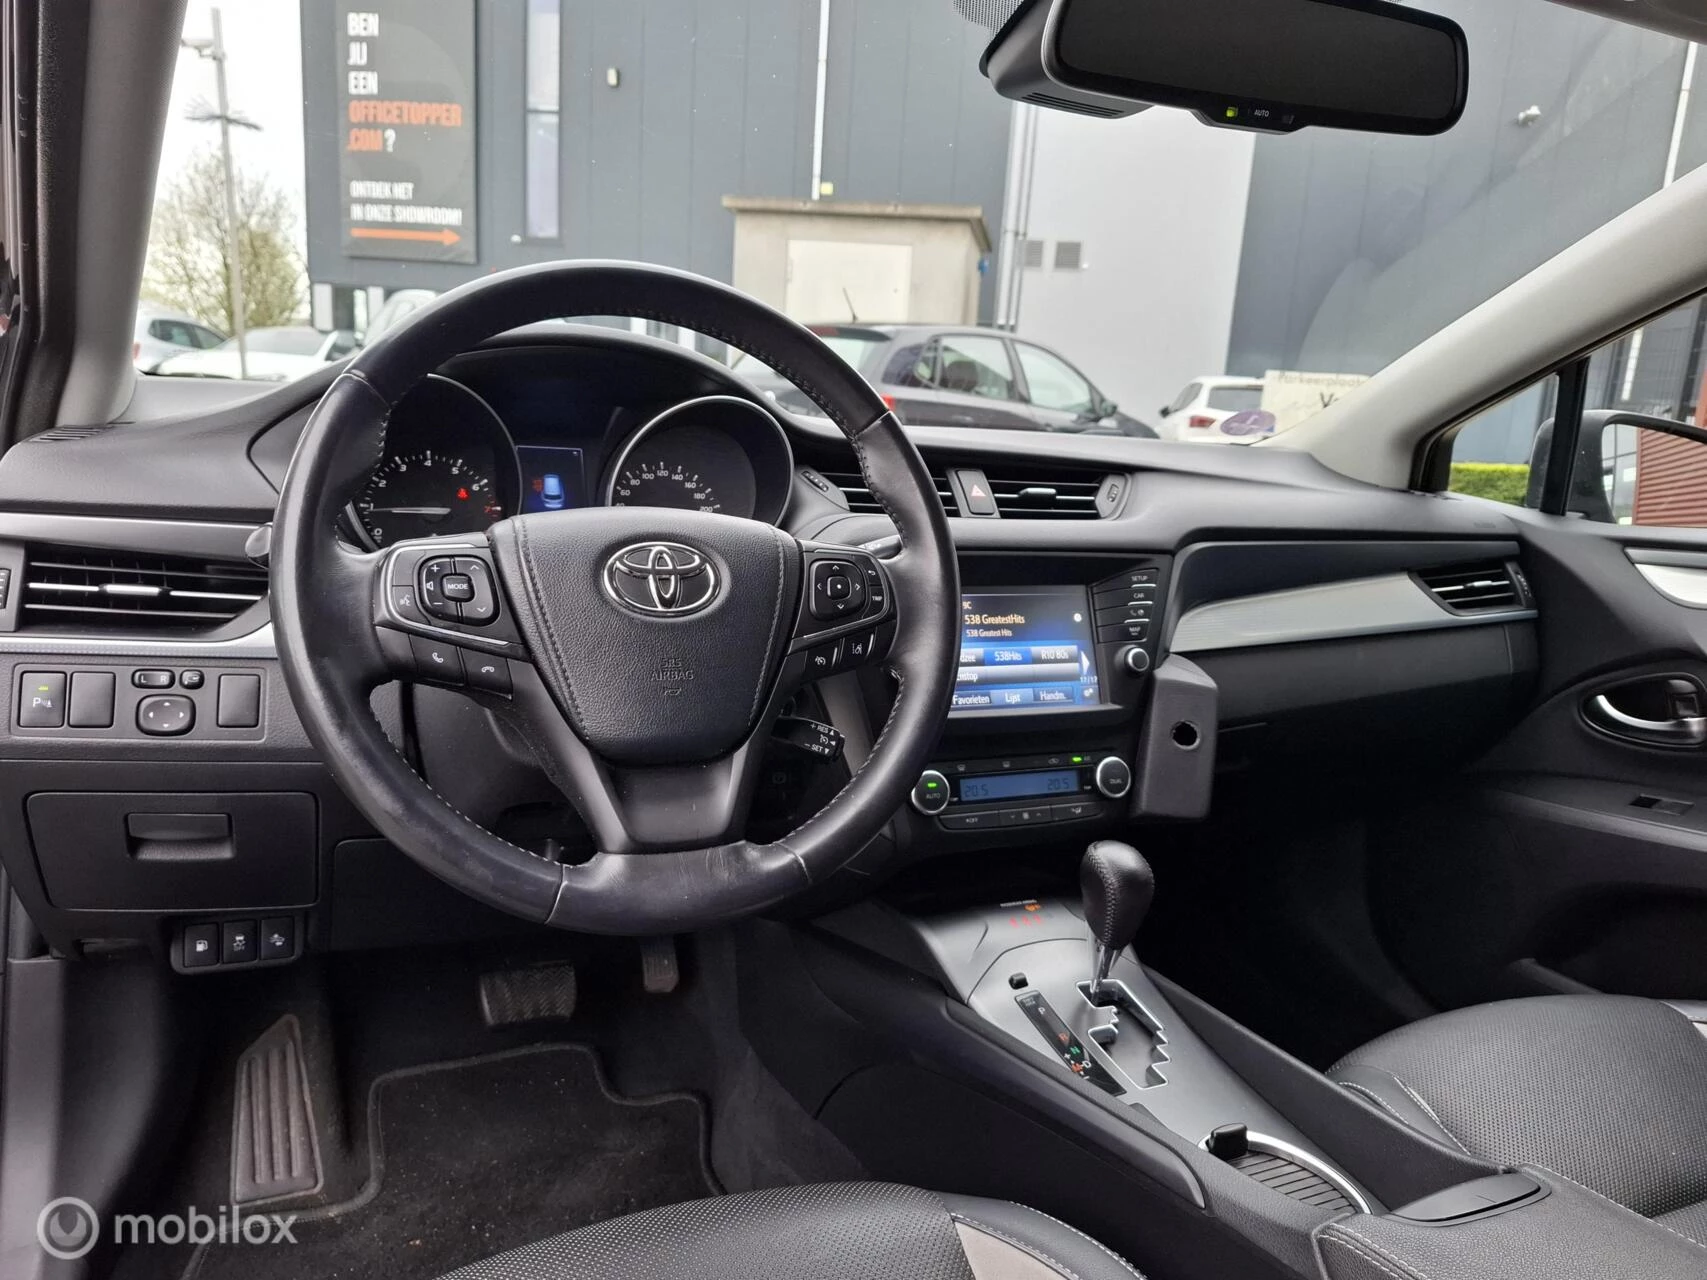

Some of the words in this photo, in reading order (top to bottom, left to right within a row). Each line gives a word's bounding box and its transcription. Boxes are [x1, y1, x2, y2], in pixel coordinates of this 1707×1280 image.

[347, 12, 379, 36] BEN
[348, 71, 378, 94] EEN
[349, 100, 462, 126] OFFICETOPPER
[1254, 109, 1269, 117] AUTO
[350, 180, 391, 198] ONTDEK
[392, 182, 414, 200] HET
[351, 203, 363, 220] IN
[364, 204, 392, 222] ONZE
[400, 464, 407, 472] 3
[452, 467, 459, 475] 5
[964, 614, 981, 625] 538
[966, 629, 978, 637] 538
[994, 650, 1022, 661] 538Hits
[661, 658, 682, 668] SRS
[140, 675, 147, 683] L
[160, 675, 167, 683] R
[650, 669, 694, 681] AIRBAG
[952, 694, 990, 705] Favorieten
[817, 725, 829, 733] RES
[811, 743, 823, 752] SET
